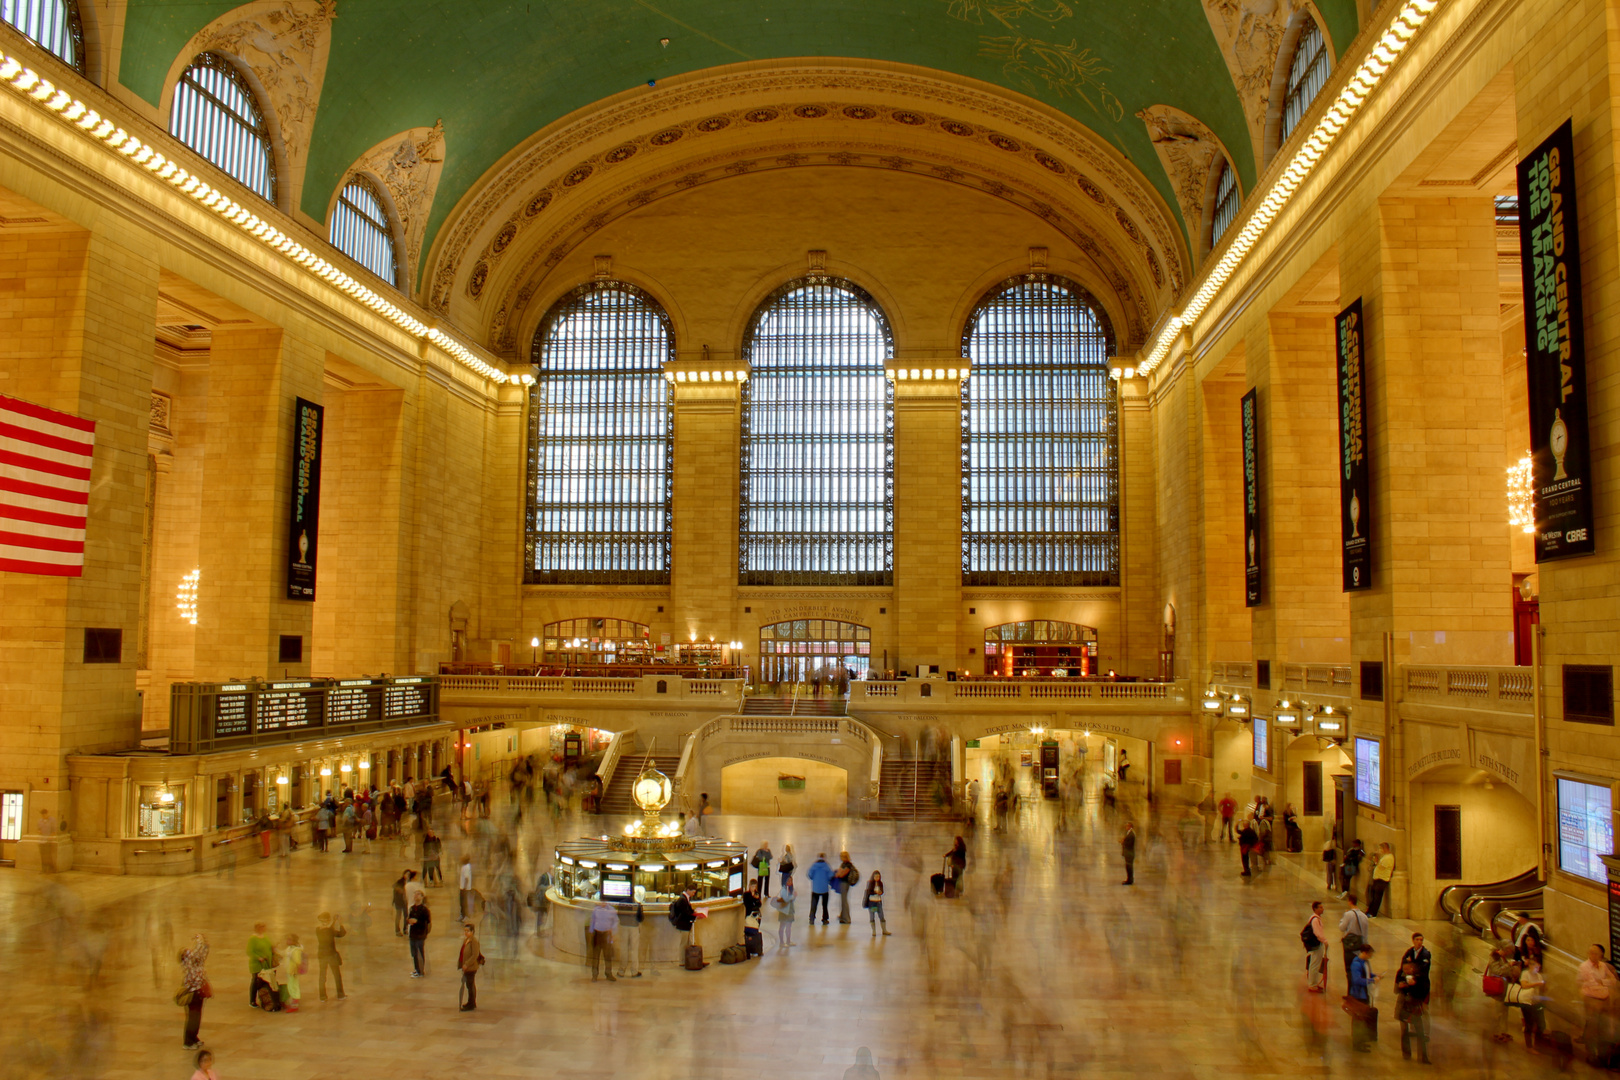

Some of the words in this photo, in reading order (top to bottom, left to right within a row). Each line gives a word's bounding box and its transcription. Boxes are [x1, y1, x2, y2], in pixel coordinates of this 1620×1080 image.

[1528, 159, 1541, 220] THE
[1538, 151, 1551, 210] 100
[1549, 146, 1565, 257] GRAND
[1540, 211, 1557, 315] YEARS
[1531, 225, 1546, 352] MAKING
[1351, 312, 1358, 329] A
[1547, 320, 1559, 354] IN
[1555, 261, 1574, 403] CENTRAL
[1340, 319, 1348, 373] ISN'T
[1342, 377, 1349, 397] IT
[1346, 315, 1356, 461] CELEBRATION
[1352, 330, 1362, 466] CENTENNIAL
[299, 405, 308, 457] GRAND
[309, 409, 318, 460] GRAND
[1343, 401, 1351, 480] GRAND
[302, 407, 313, 496] CENTENNIAL
[296, 459, 306, 523] CENTRAL
[1541, 484, 1557, 495] GRAND
[1557, 478, 1581, 490] CENTRAL
[1559, 494, 1574, 504] YEARS
[1566, 528, 1588, 543] CBRE
[784, 605, 828, 613] VANDERBILT
[832, 606, 860, 616] AVENUE
[824, 612, 864, 623] APARTMENT
[465, 715, 492, 725] SUBWAY
[494, 713, 523, 721] SHUTTLE
[564, 716, 589, 725] STREET
[985, 724, 1009, 734] TICKET
[1073, 721, 1102, 729] TRACKS
[743, 751, 771, 759] CONCOURSE
[1407, 763, 1418, 776] THE
[1436, 748, 1461, 761] BUILDING
[1495, 761, 1519, 784] STREET
